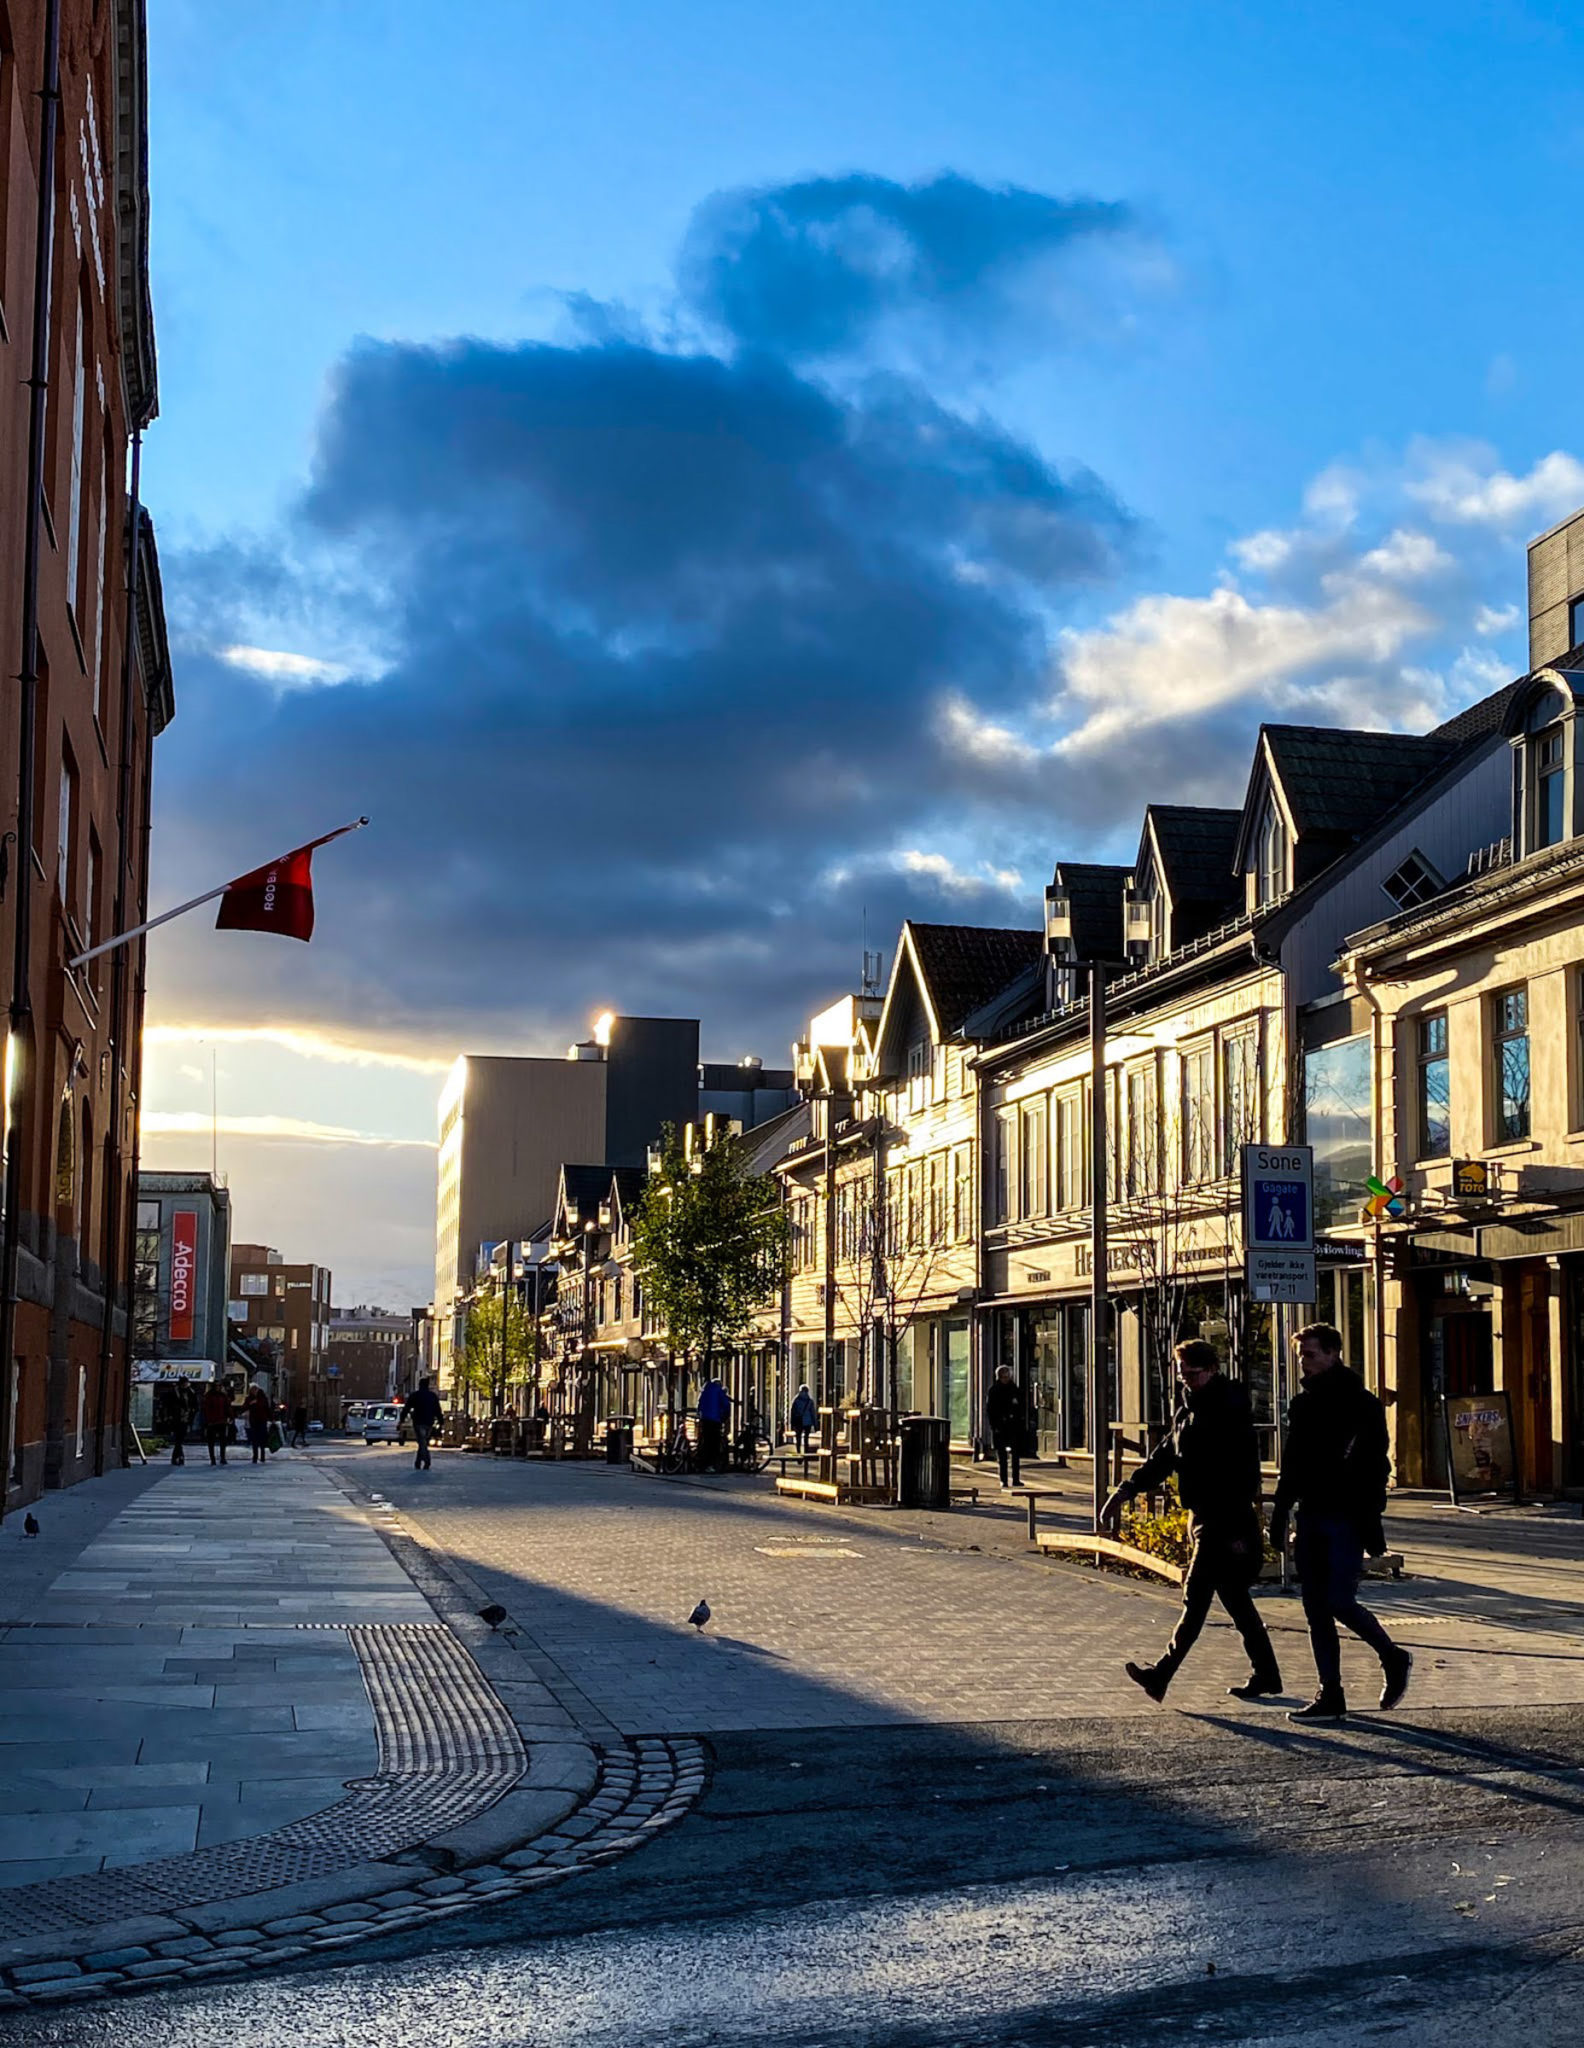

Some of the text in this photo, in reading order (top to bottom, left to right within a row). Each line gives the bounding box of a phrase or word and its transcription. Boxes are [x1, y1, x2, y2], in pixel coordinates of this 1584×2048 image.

[1258, 1151, 1302, 1171] Sone
[1262, 1181, 1298, 1195] Gågate
[1459, 1183, 1485, 1194] TOTO
[1258, 1259, 1305, 1270] Gjelder ikke
[172, 1240, 193, 1311] Adecco
[1255, 1270, 1308, 1281] varetransport
[162, 1364, 200, 1380] joker
[1456, 1411, 1499, 1426] SNIKERS
